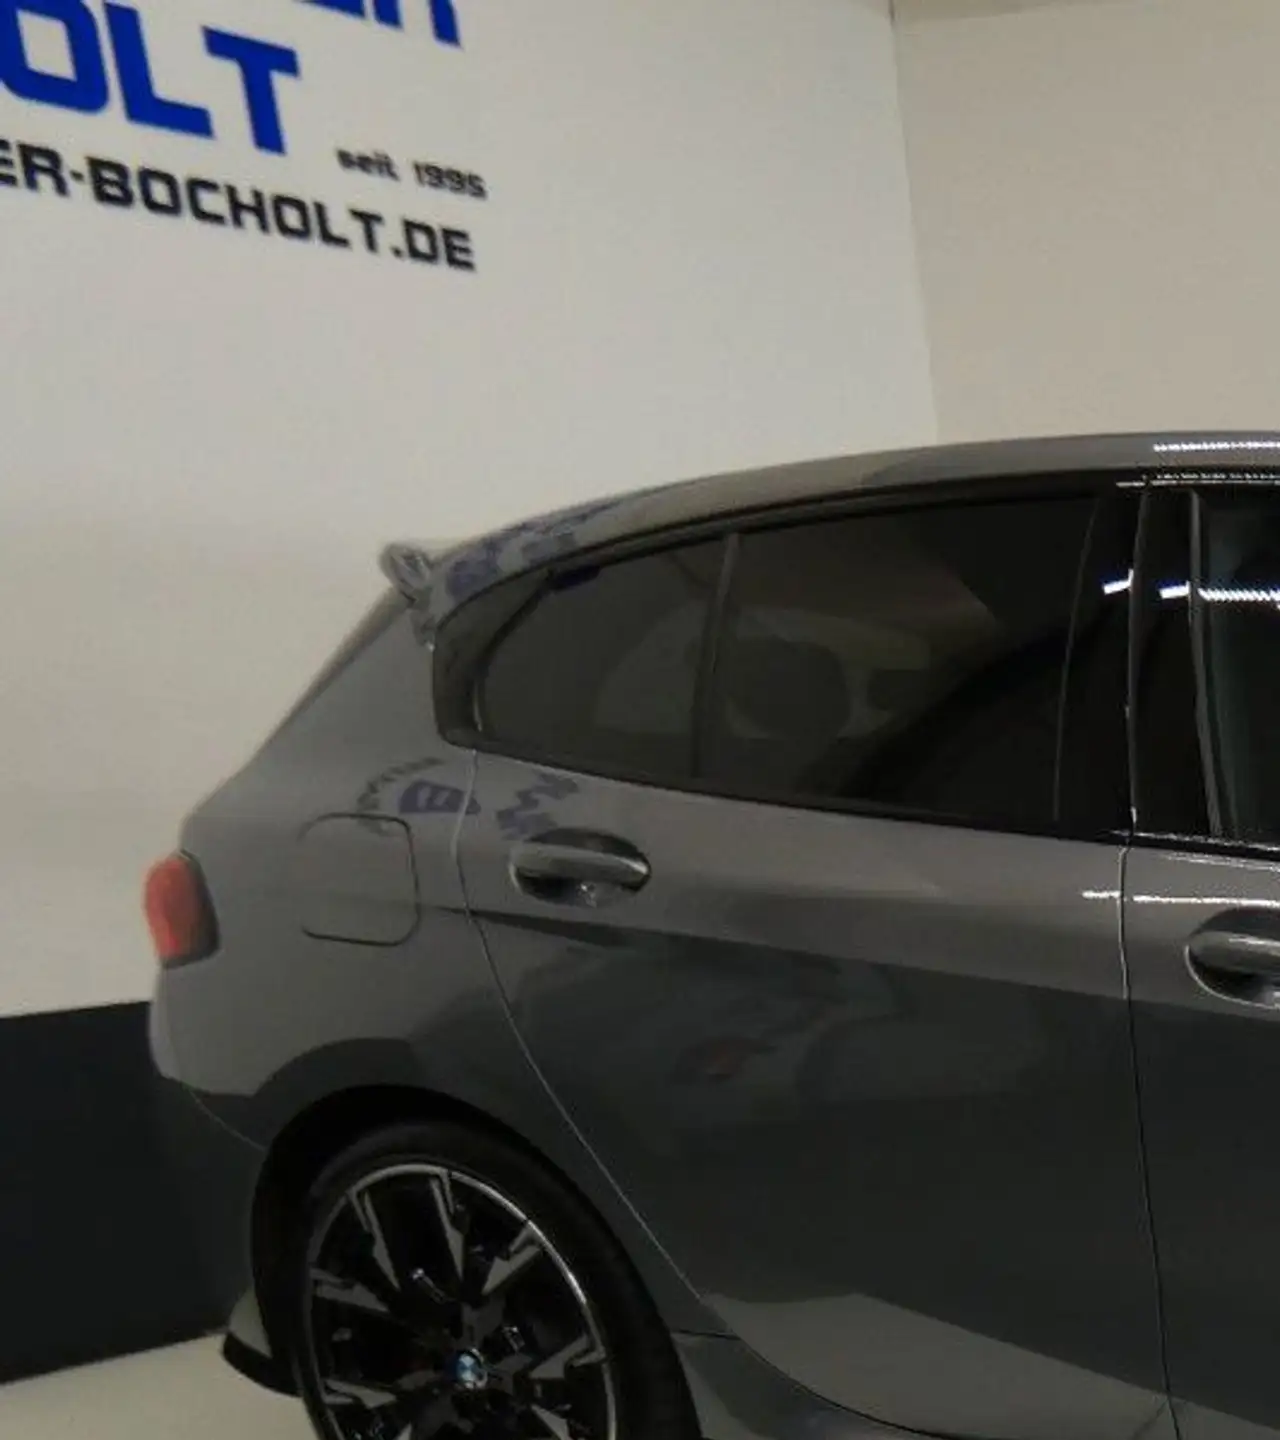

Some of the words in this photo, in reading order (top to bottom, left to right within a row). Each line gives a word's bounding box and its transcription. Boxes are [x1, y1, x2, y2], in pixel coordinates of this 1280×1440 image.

[0, 0, 299, 155] OLT
[336, 148, 398, 181] seit
[412, 161, 487, 199] 1995
